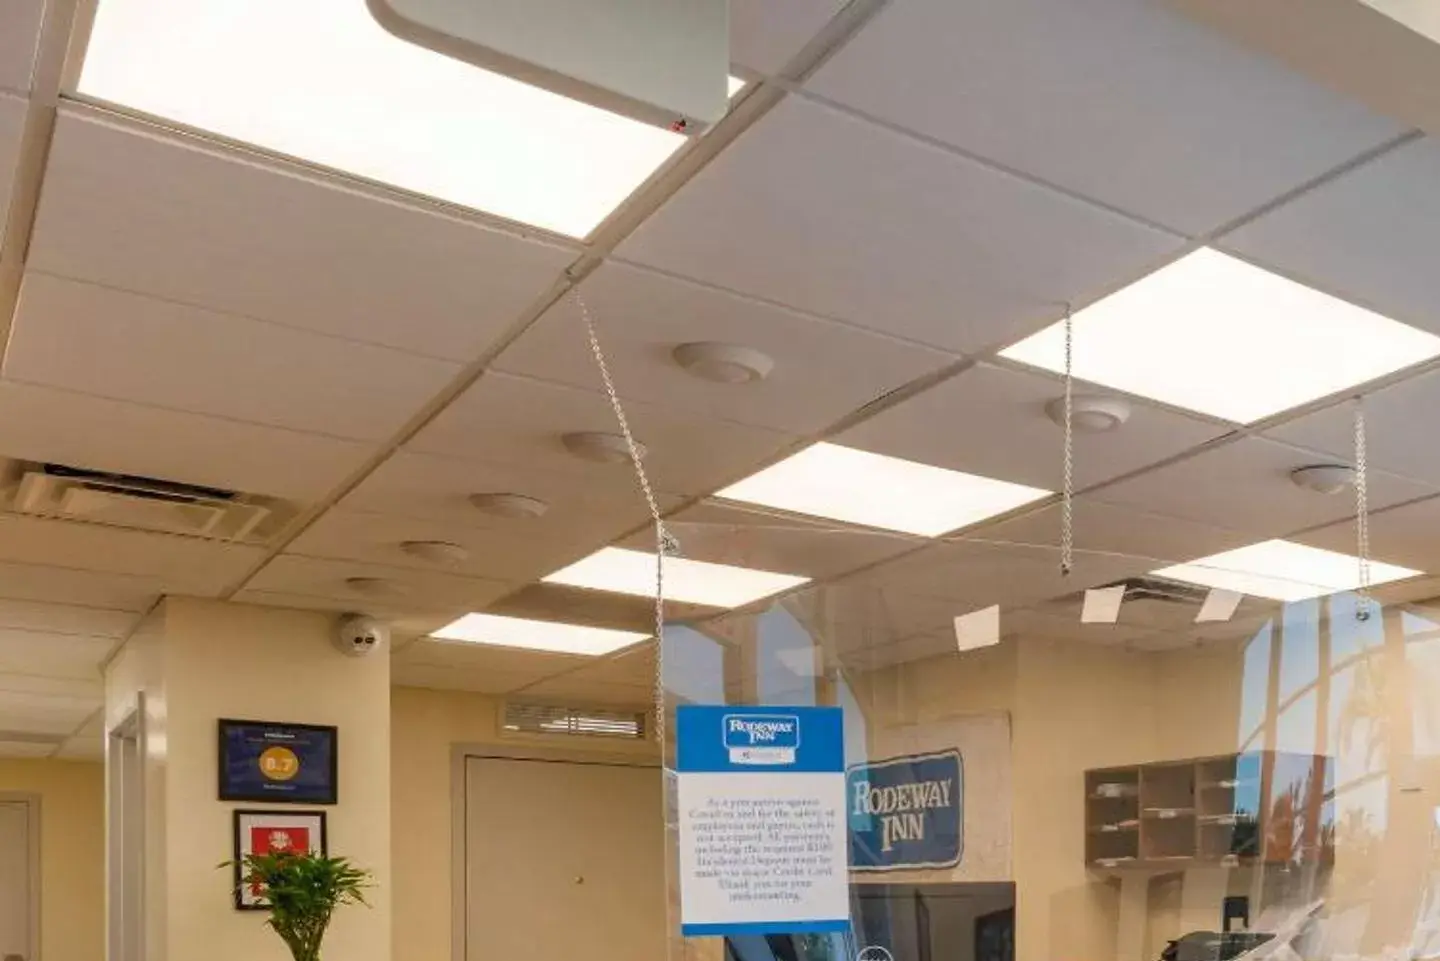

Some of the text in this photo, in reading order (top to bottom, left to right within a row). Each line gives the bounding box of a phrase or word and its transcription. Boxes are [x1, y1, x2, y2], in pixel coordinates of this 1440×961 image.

[729, 719, 795, 733] RODEWAY
[749, 730, 777, 744] INN
[853, 778, 953, 815] RODEWAY
[881, 813, 924, 851] INN
